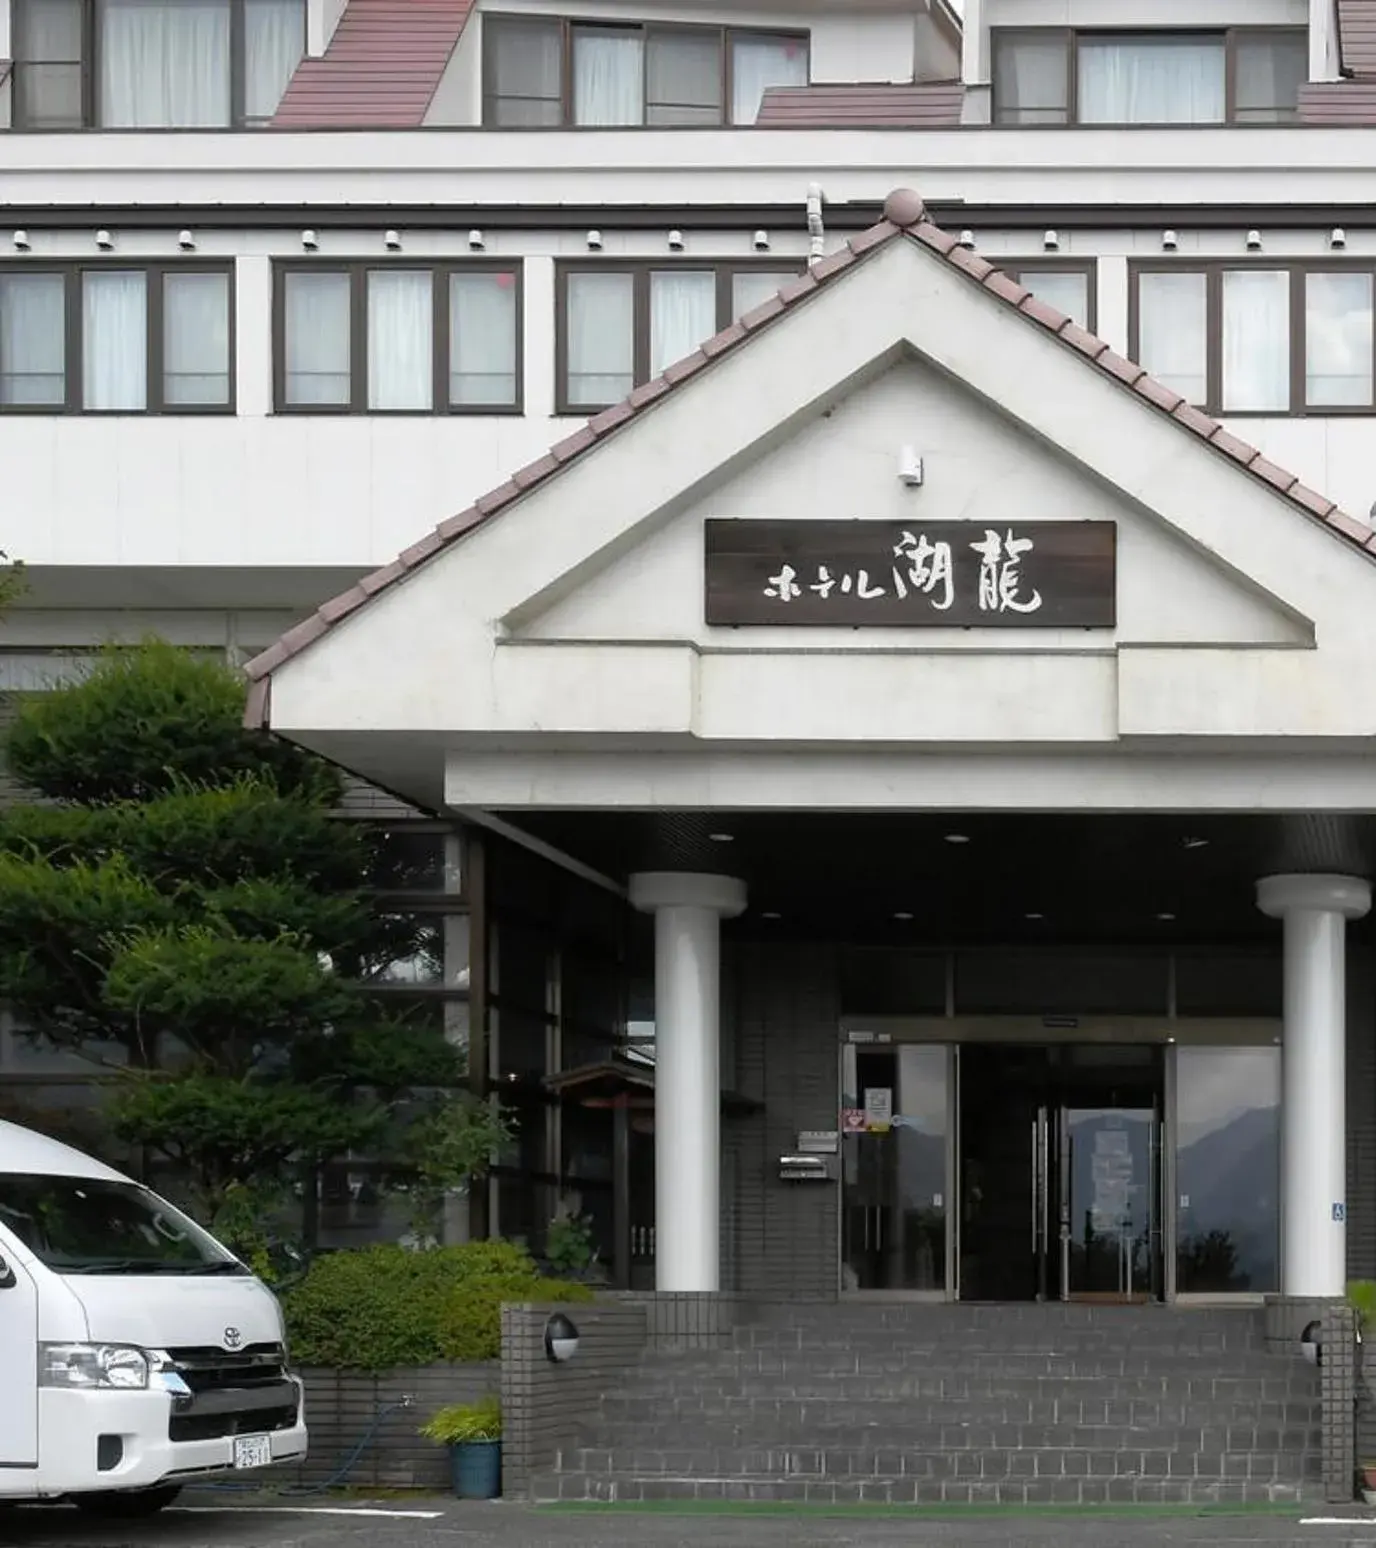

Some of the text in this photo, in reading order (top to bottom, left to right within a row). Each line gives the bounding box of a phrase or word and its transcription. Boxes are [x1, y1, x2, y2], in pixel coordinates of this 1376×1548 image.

[763, 527, 1042, 614] ホテル湖龍
